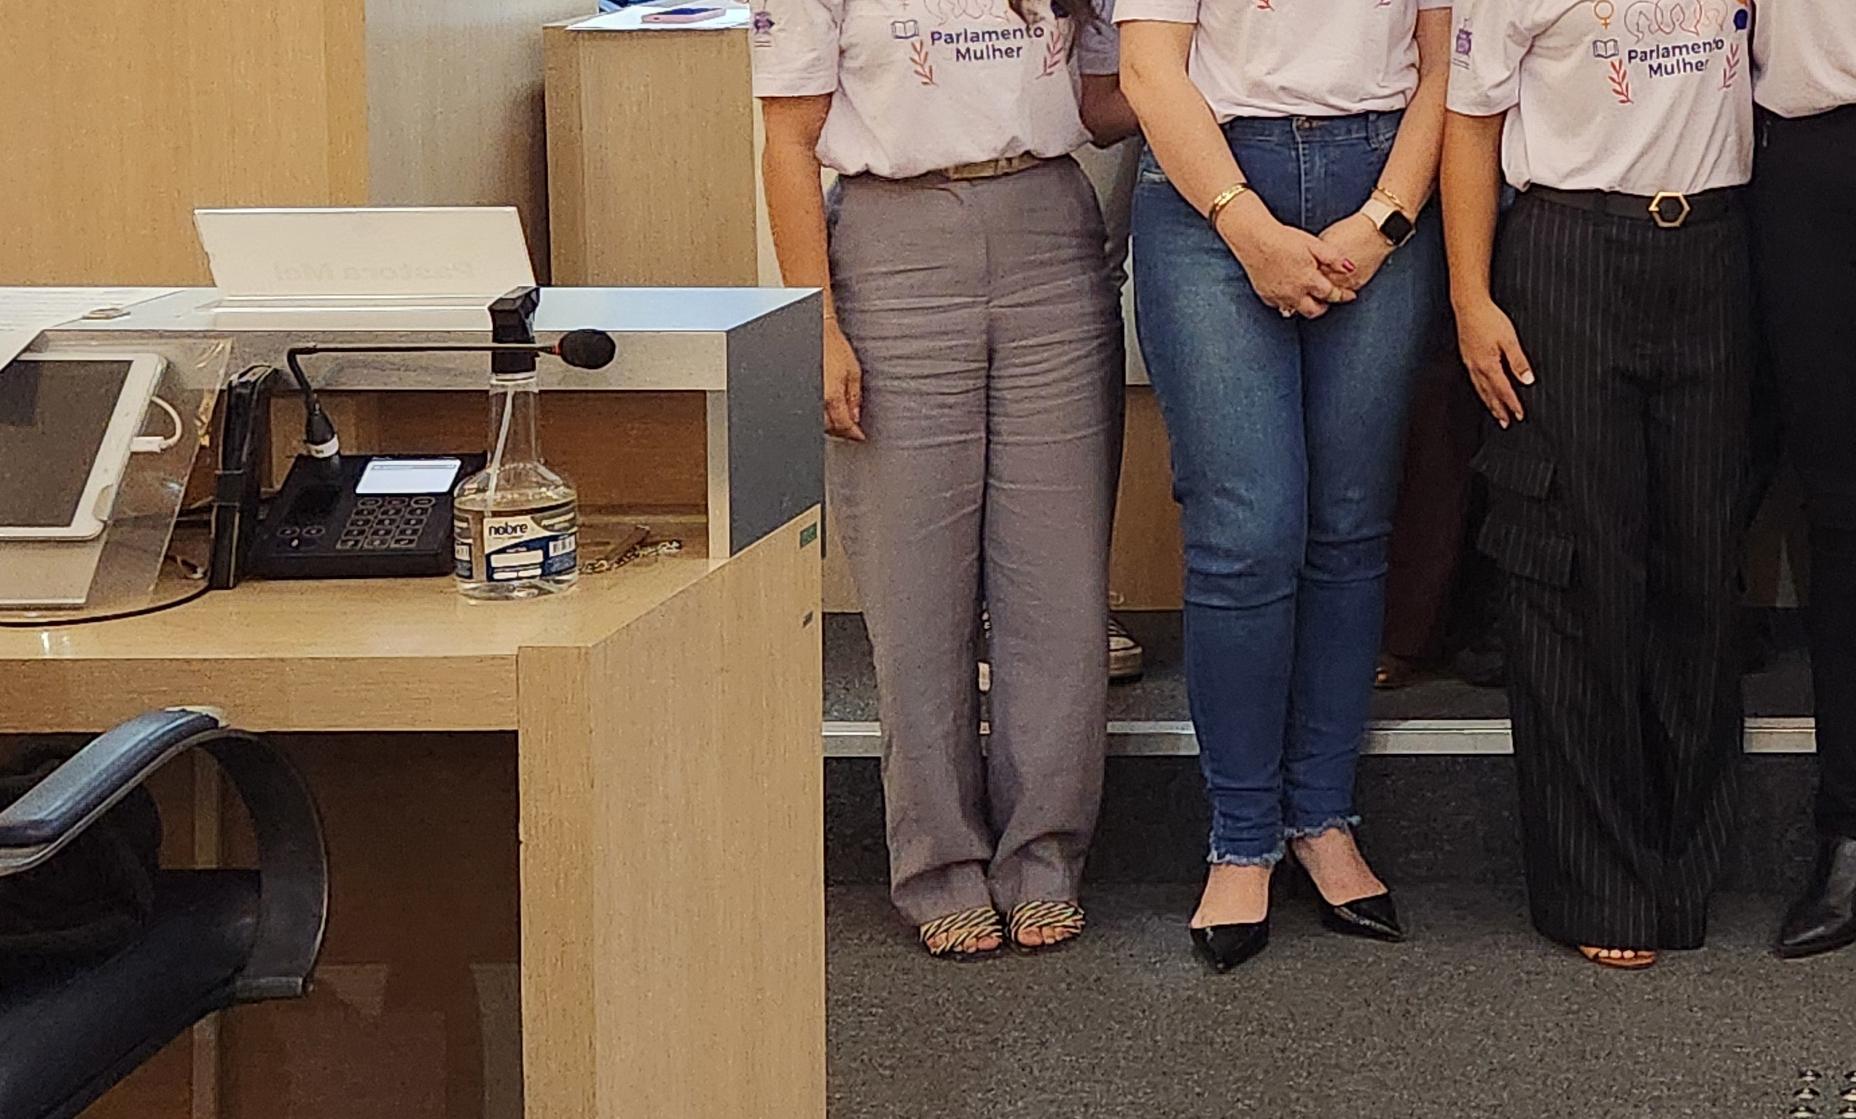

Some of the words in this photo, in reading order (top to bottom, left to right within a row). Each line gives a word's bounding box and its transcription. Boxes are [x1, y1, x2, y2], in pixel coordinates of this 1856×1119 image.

[930, 25, 1045, 46] Parlamento
[955, 44, 1023, 62] Mulher
[488, 522, 529, 537] nobre
